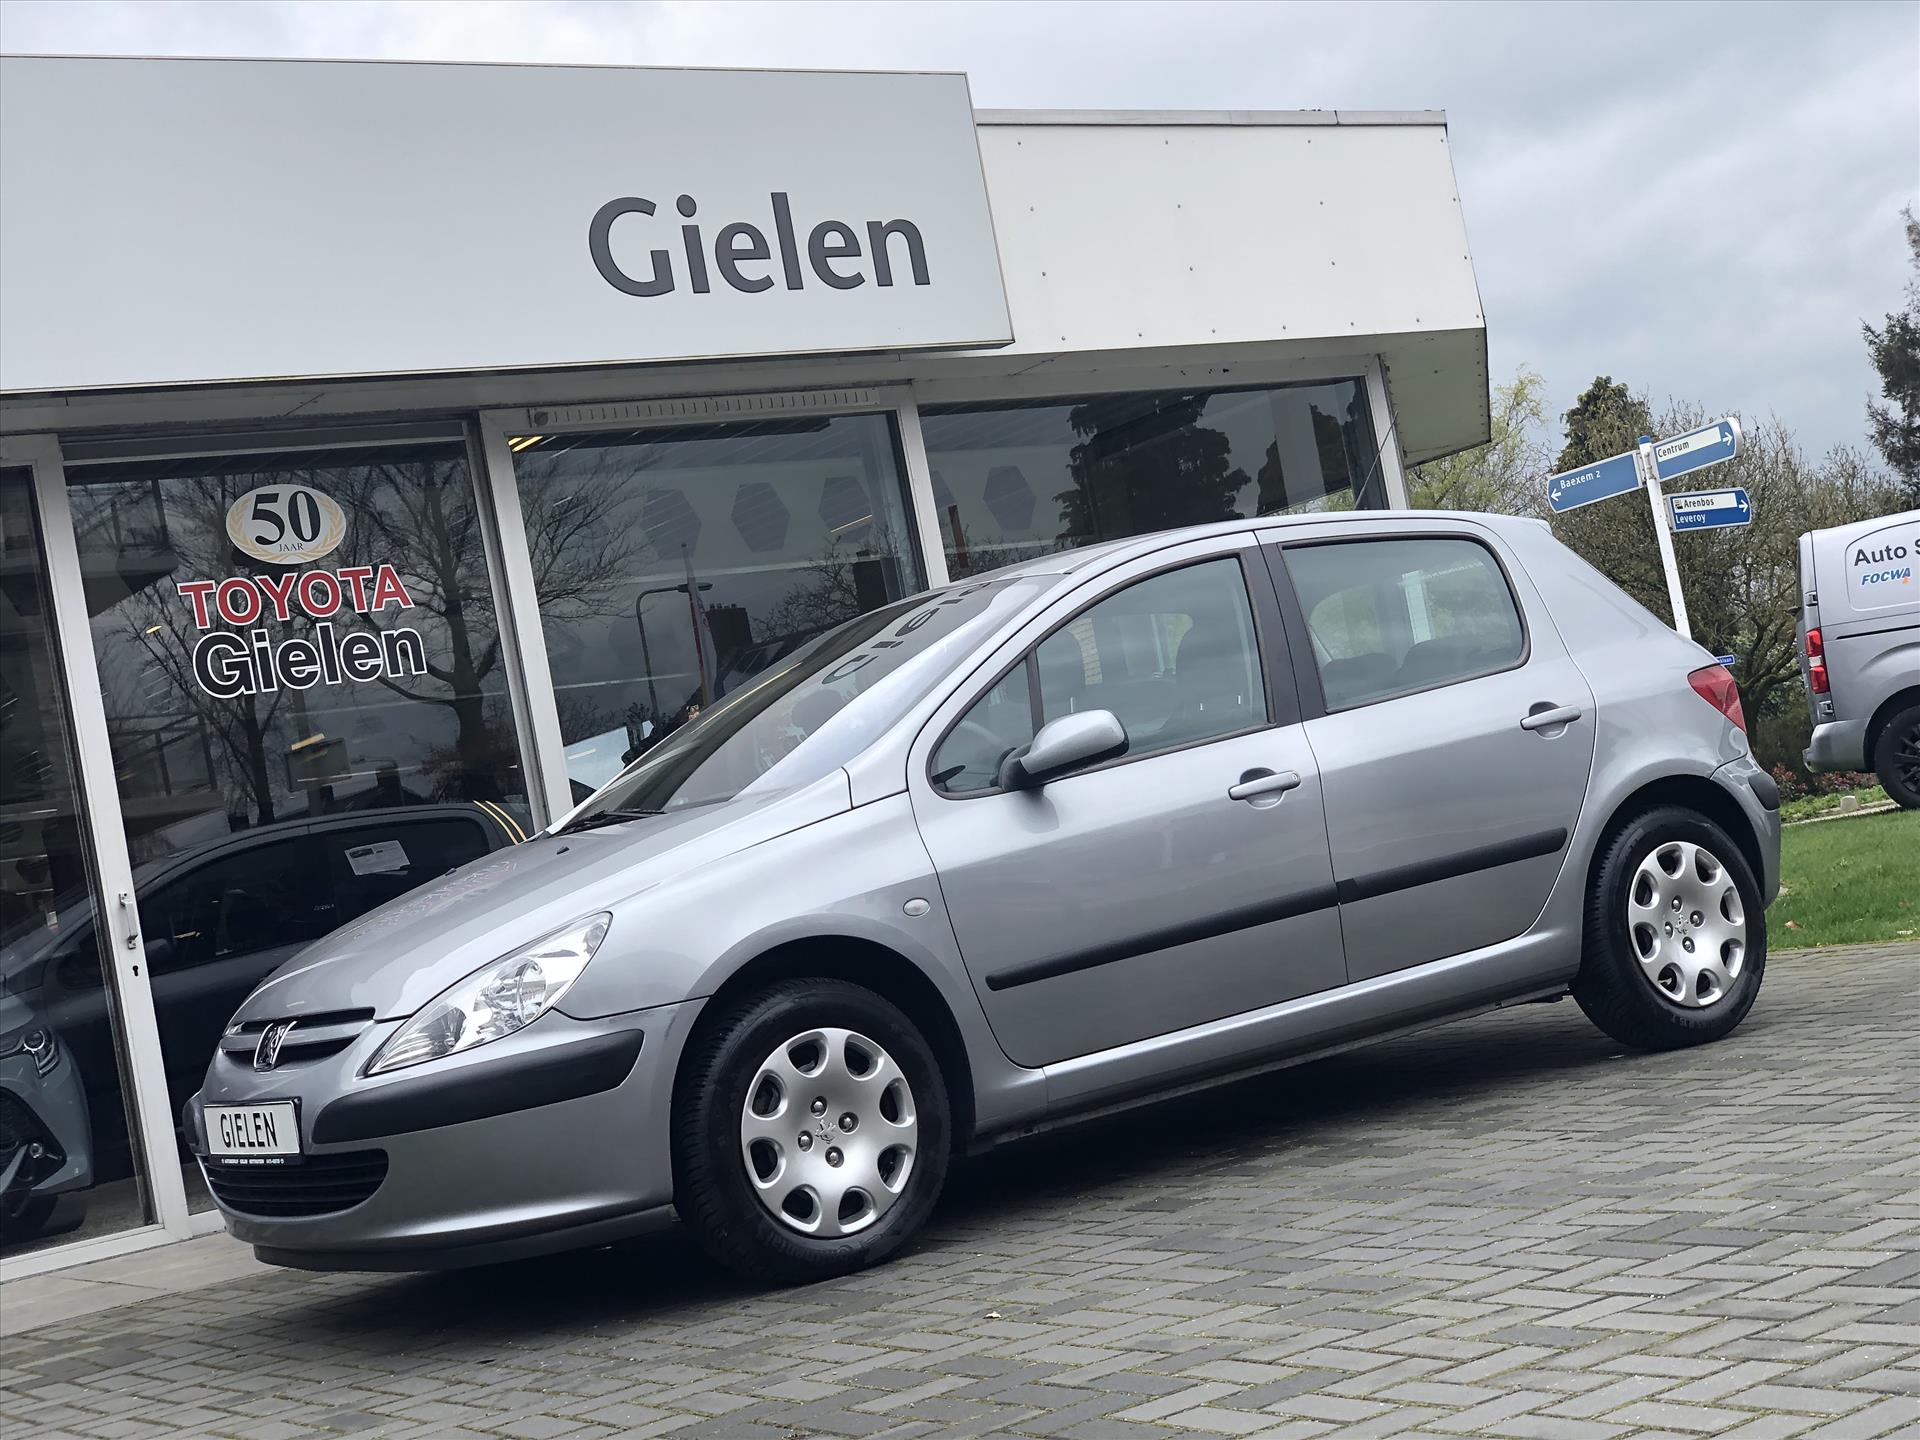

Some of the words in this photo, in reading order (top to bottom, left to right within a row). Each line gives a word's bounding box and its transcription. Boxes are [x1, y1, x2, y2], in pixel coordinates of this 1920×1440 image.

[588, 191, 931, 298] Gielen
[1657, 440, 1690, 458] Centrum
[1560, 471, 1594, 490] Baexem
[1596, 470, 1601, 478] 2
[1683, 497, 1715, 509] Arenbos
[251, 490, 321, 546] 50
[1675, 513, 1706, 525] Leveroy
[278, 542, 304, 553] JAAR
[1854, 545, 1908, 567] Auto
[1861, 567, 1911, 586] FOCWA
[177, 563, 415, 630] TOYOTA
[192, 622, 428, 699] Gielen
[219, 1111, 278, 1149] GIELEN
